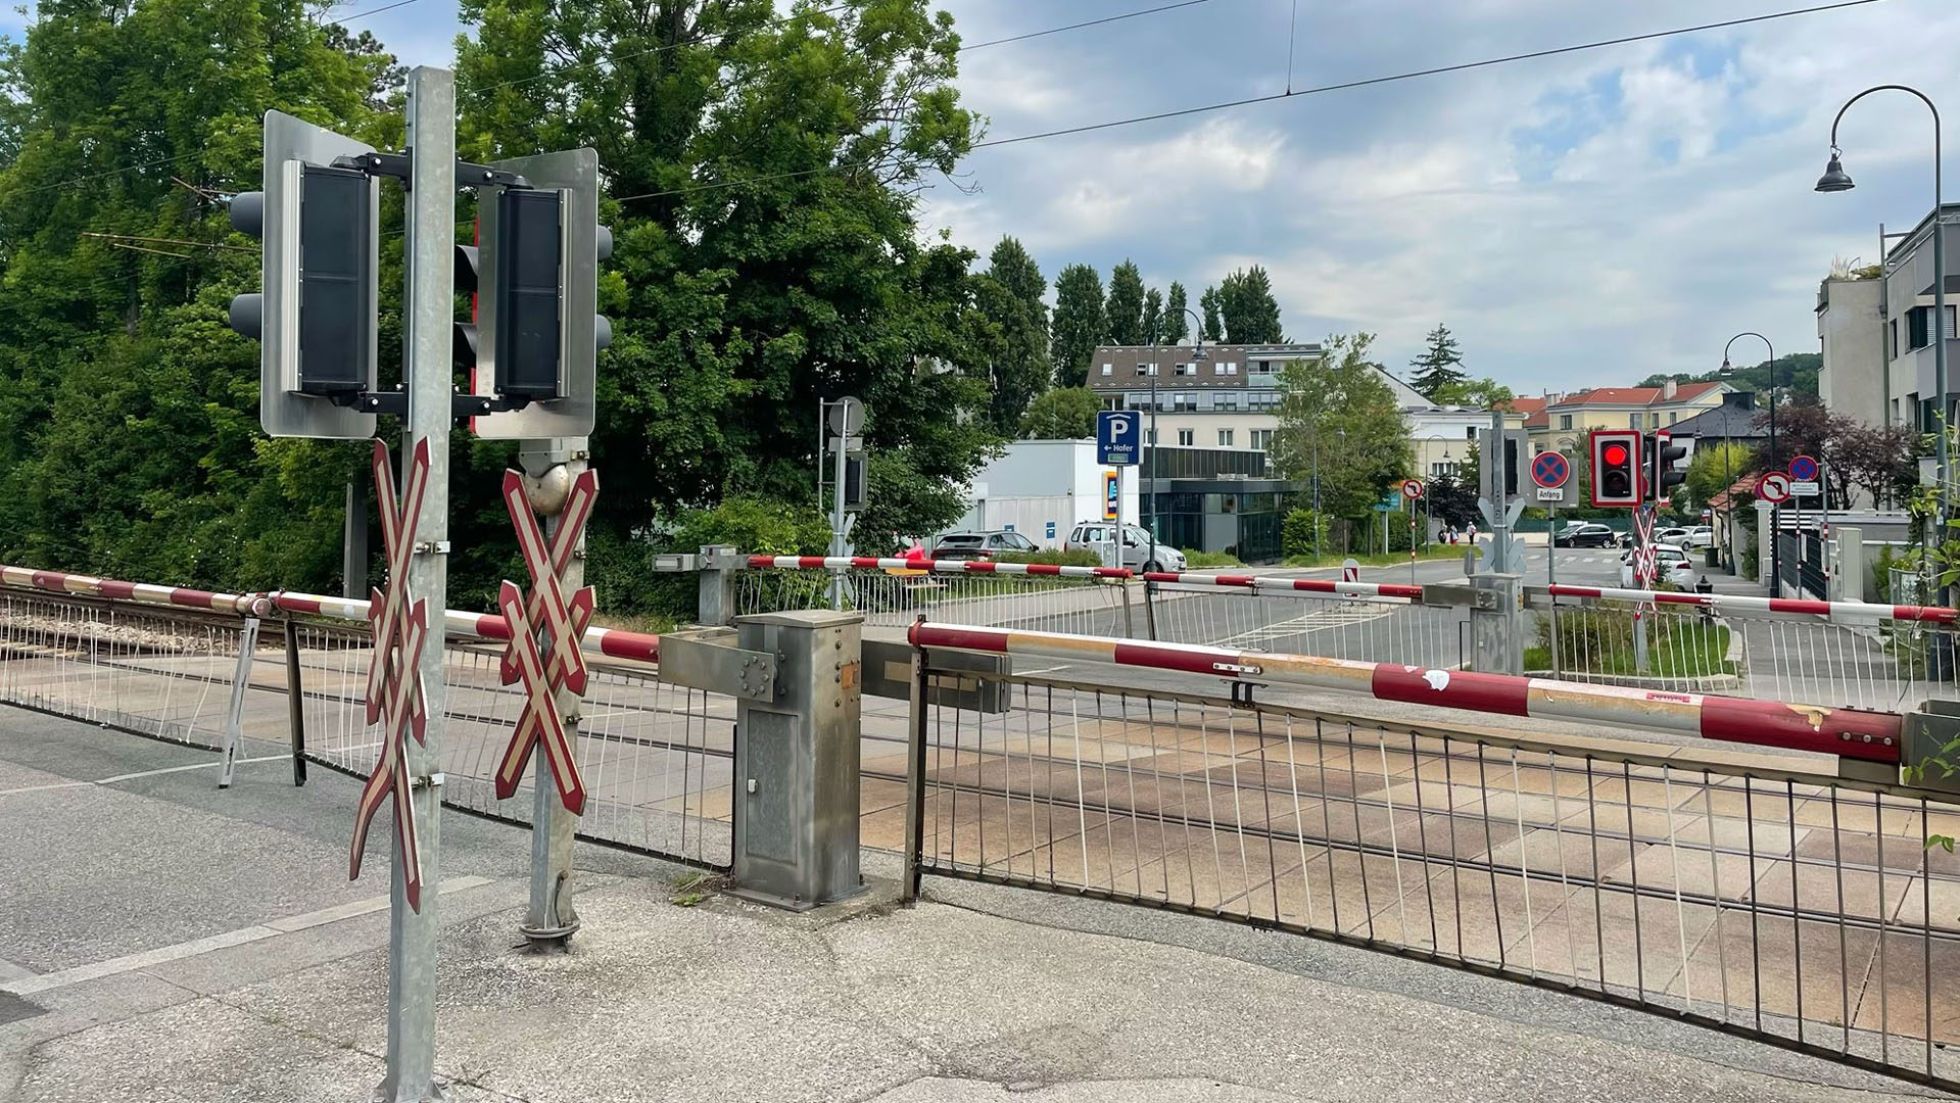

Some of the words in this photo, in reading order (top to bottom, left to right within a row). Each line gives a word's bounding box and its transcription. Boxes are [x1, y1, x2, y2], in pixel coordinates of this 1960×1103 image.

[1111, 420, 1128, 443] P
[1113, 444, 1133, 452] Hofer
[1539, 490, 1560, 499] Anfang
